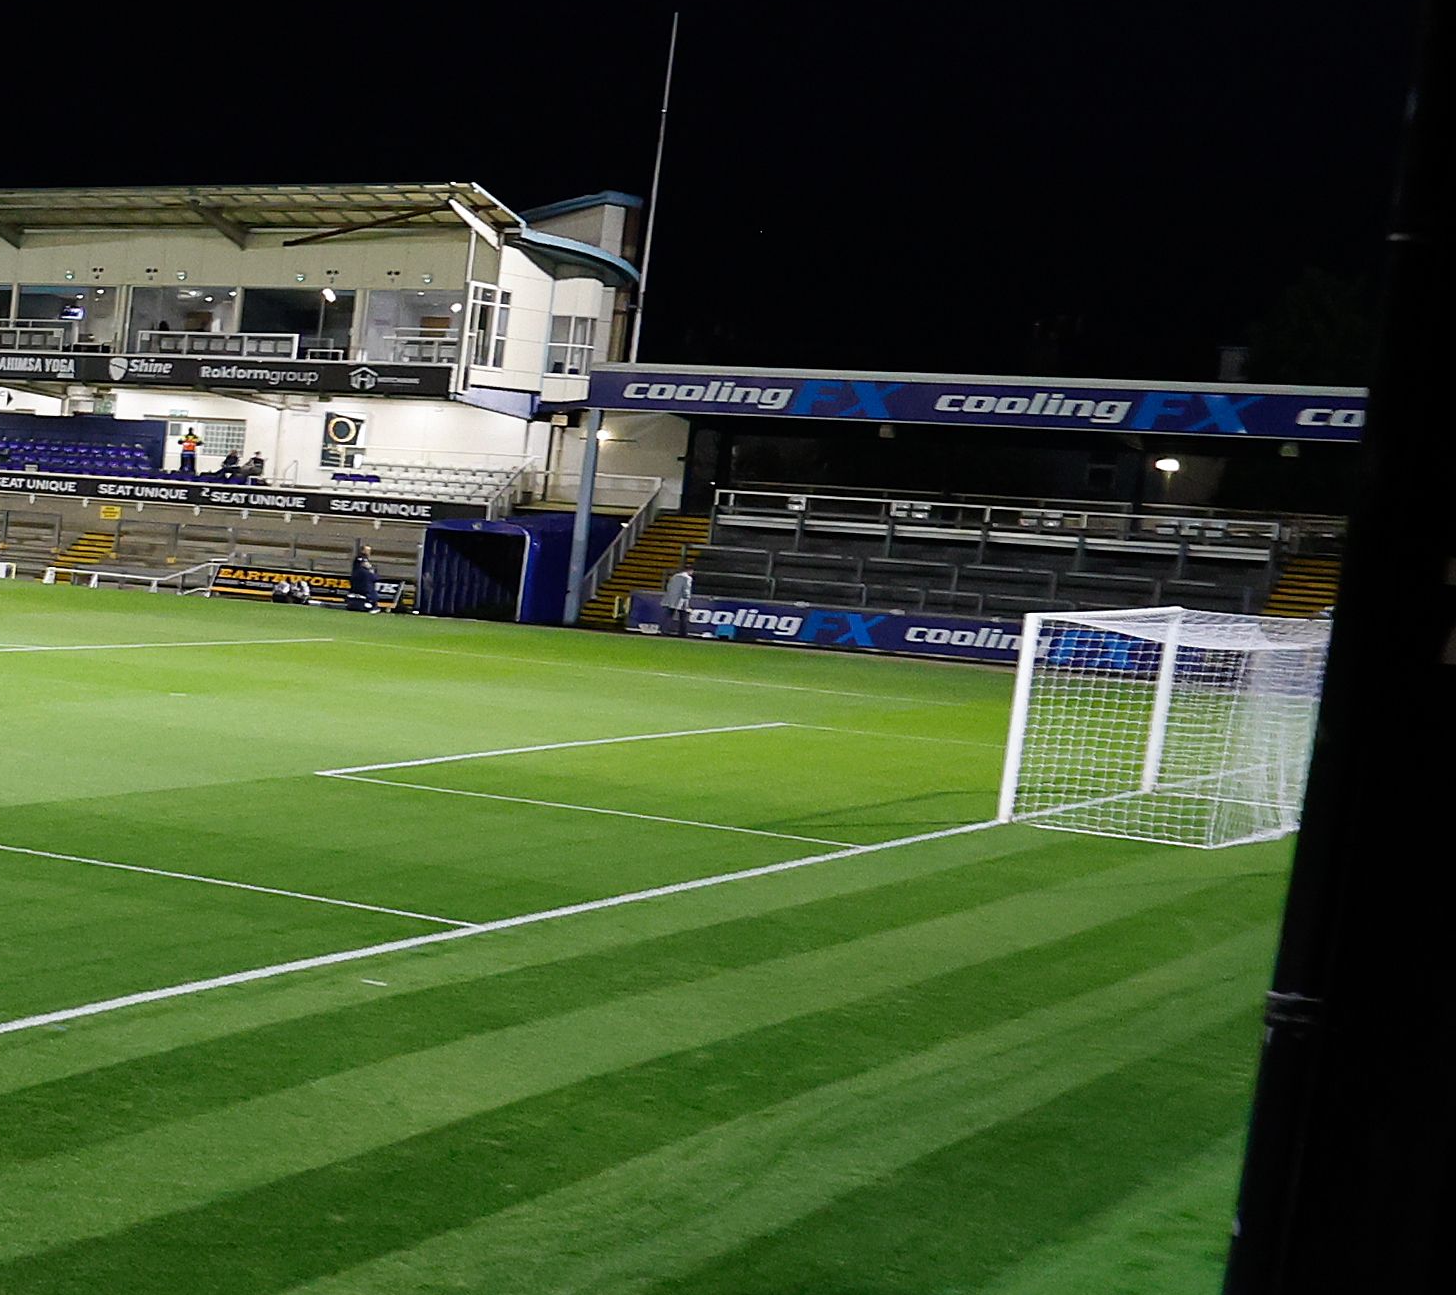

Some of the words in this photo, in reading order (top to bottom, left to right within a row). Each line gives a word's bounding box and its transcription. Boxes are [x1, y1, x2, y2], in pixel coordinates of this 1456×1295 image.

[43, 358, 75, 374] YOGA
[128, 358, 173, 375] Shine
[1295, 408, 1366, 427] co
[26, 478, 77, 493] UNIQUE
[98, 483, 133, 496] SEAT
[134, 485, 188, 500] UNIQUE
[210, 491, 247, 504] SEAT
[248, 493, 307, 508] UNIQUE
[330, 499, 370, 512] SEAT
[372, 501, 432, 518] UNIQUE
